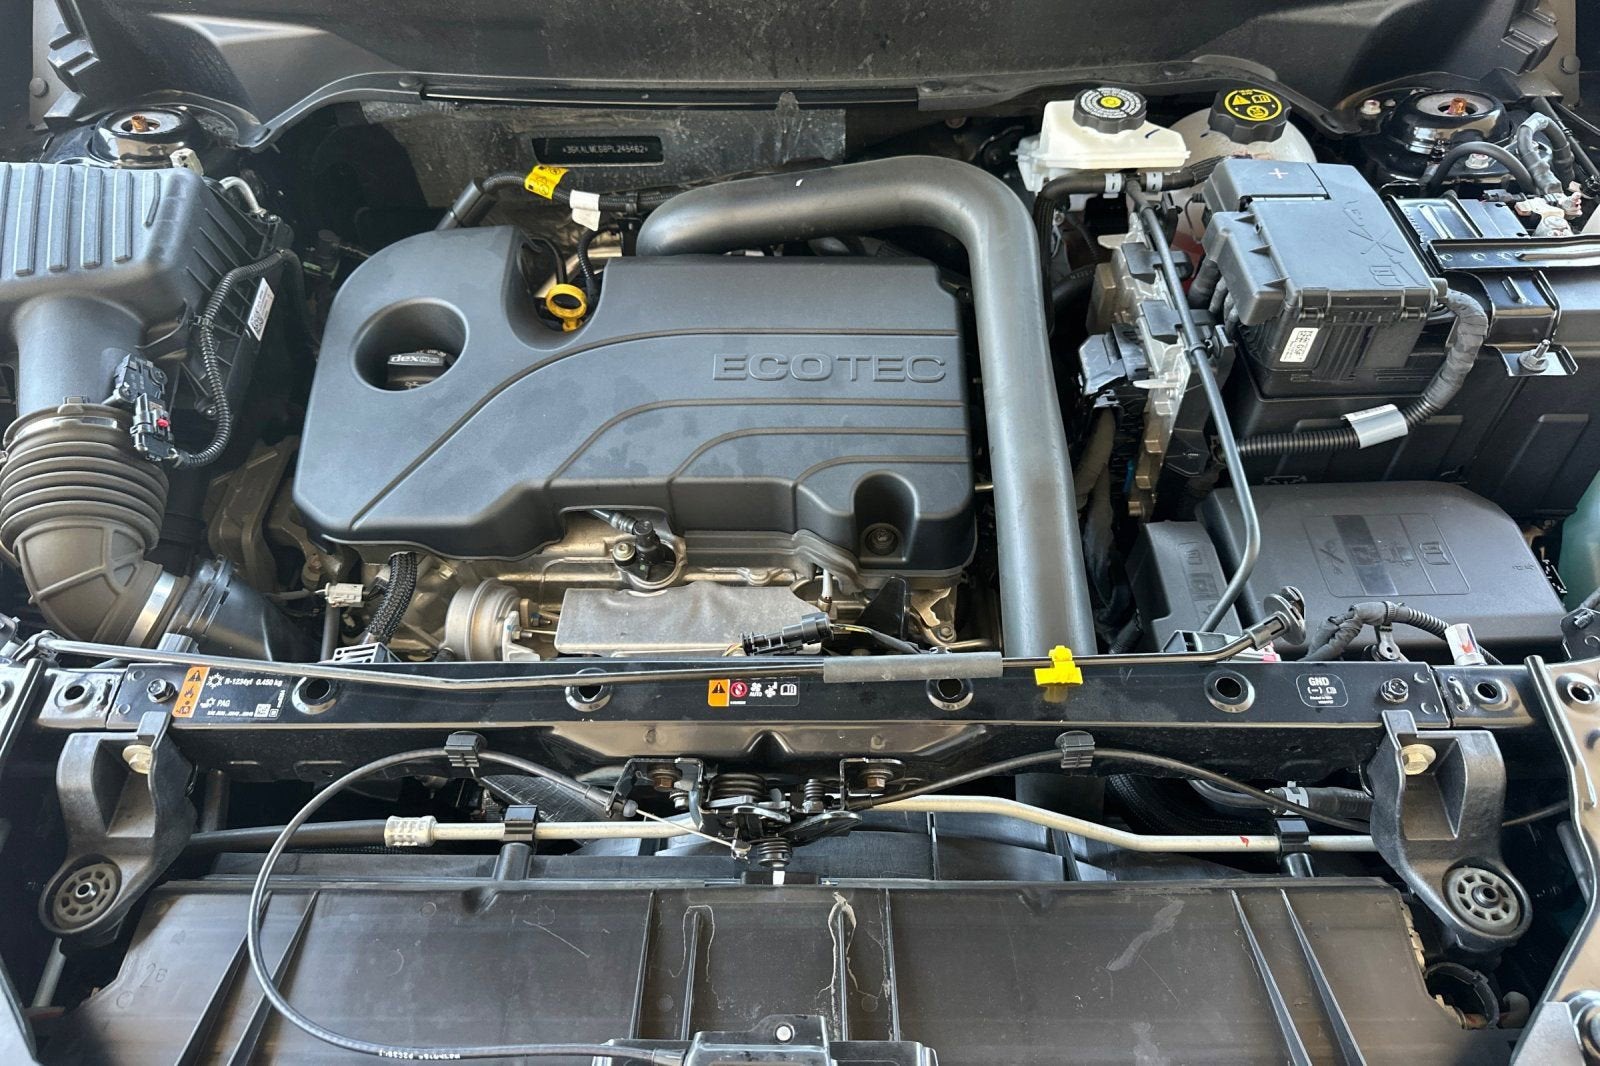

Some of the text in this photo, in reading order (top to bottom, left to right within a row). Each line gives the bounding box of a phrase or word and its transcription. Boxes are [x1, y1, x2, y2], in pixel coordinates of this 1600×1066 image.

[712, 353, 947, 383] ECOTEC
[273, 679, 283, 688] kg
[1308, 676, 1330, 686] GND
[216, 699, 231, 708] PAG
